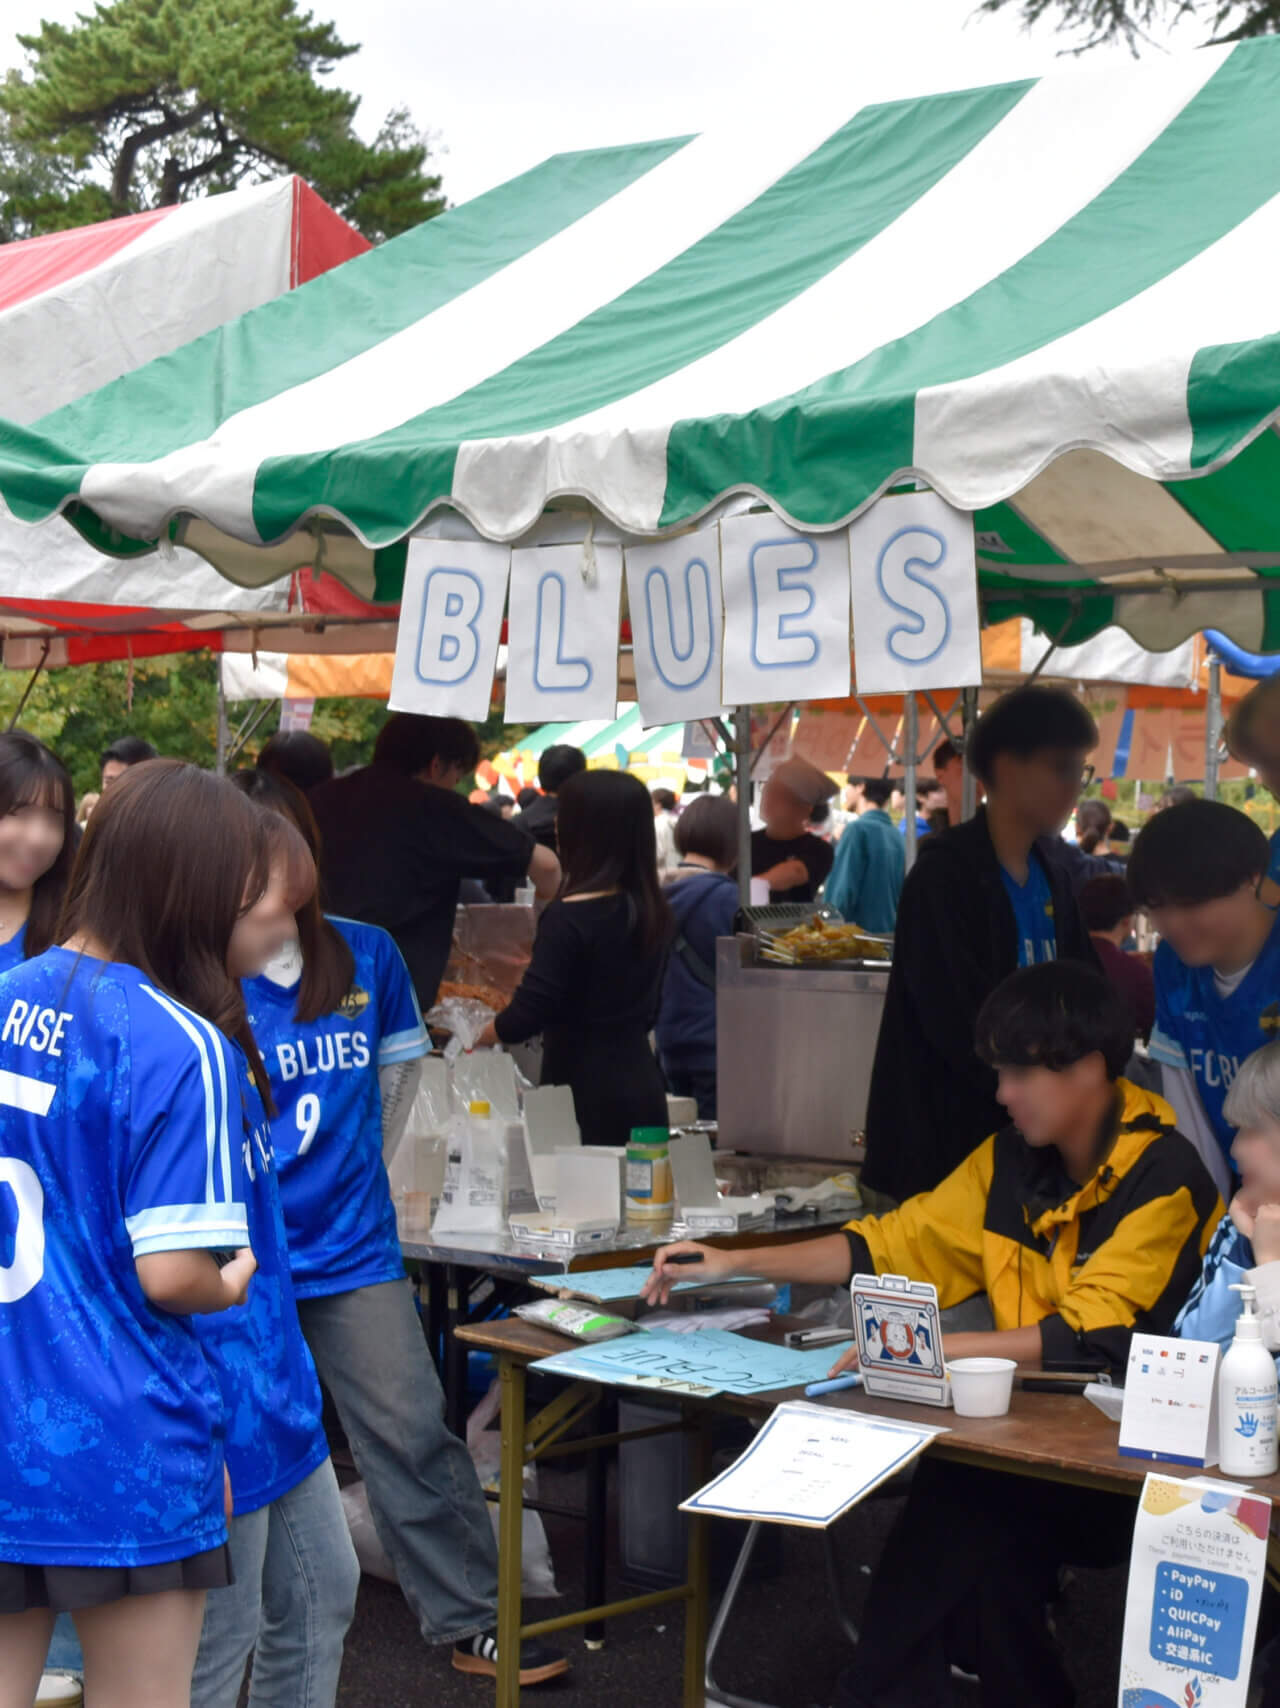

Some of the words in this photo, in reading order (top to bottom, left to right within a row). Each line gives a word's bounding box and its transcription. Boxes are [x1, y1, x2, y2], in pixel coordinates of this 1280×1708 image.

[415, 525, 952, 692] BLUES
[1, 998, 74, 1057] RISE
[276, 1031, 371, 1082] BLUES
[296, 1093, 321, 1156] 9
[1170, 1588, 1183, 1601] iD
[1171, 1570, 1217, 1592] PayPay
[1167, 1625, 1206, 1647] AliPay
[1168, 1606, 1221, 1632] QUICPay
